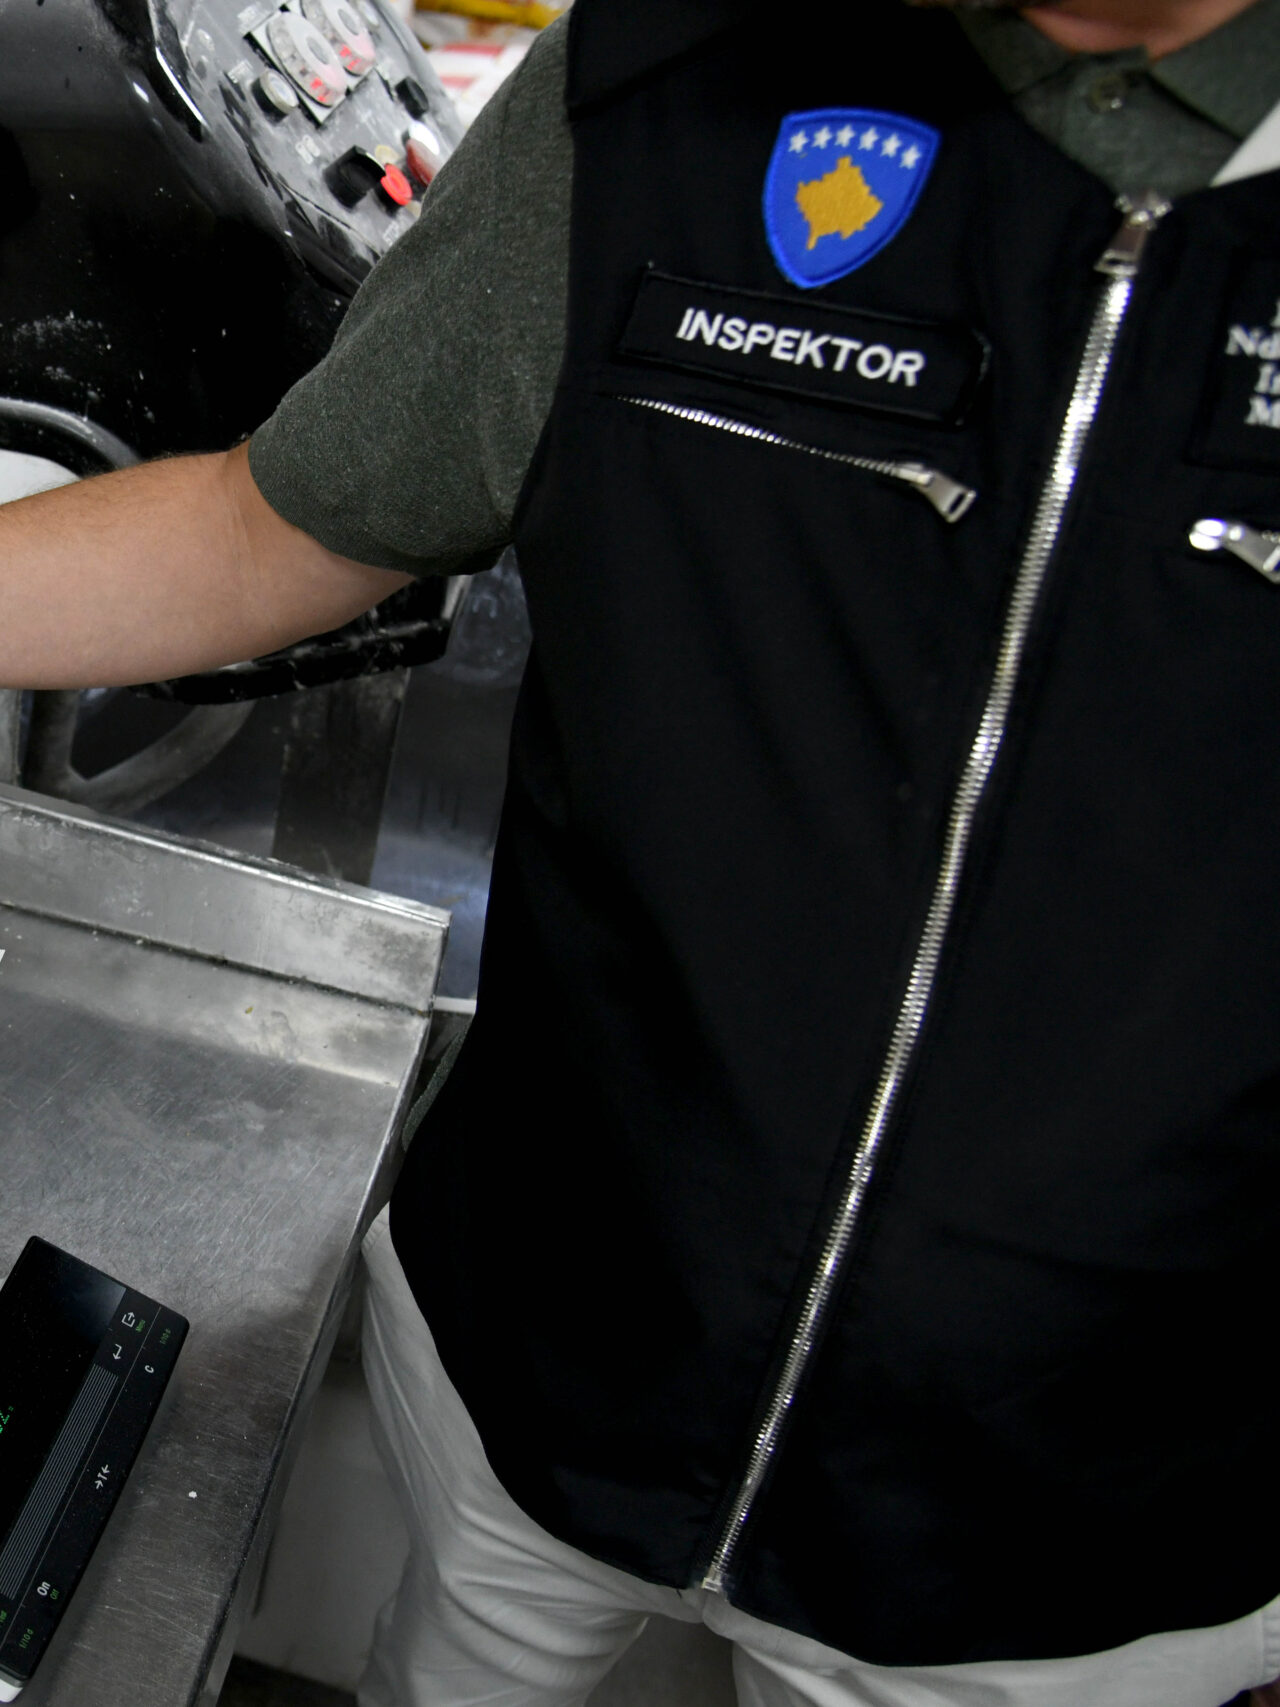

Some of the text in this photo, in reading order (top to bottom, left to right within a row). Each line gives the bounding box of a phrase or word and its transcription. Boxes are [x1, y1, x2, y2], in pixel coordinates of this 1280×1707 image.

[676, 307, 926, 387] INSPEKTOR
[144, 1365, 155, 1374] C
[37, 1581, 51, 1596] On
